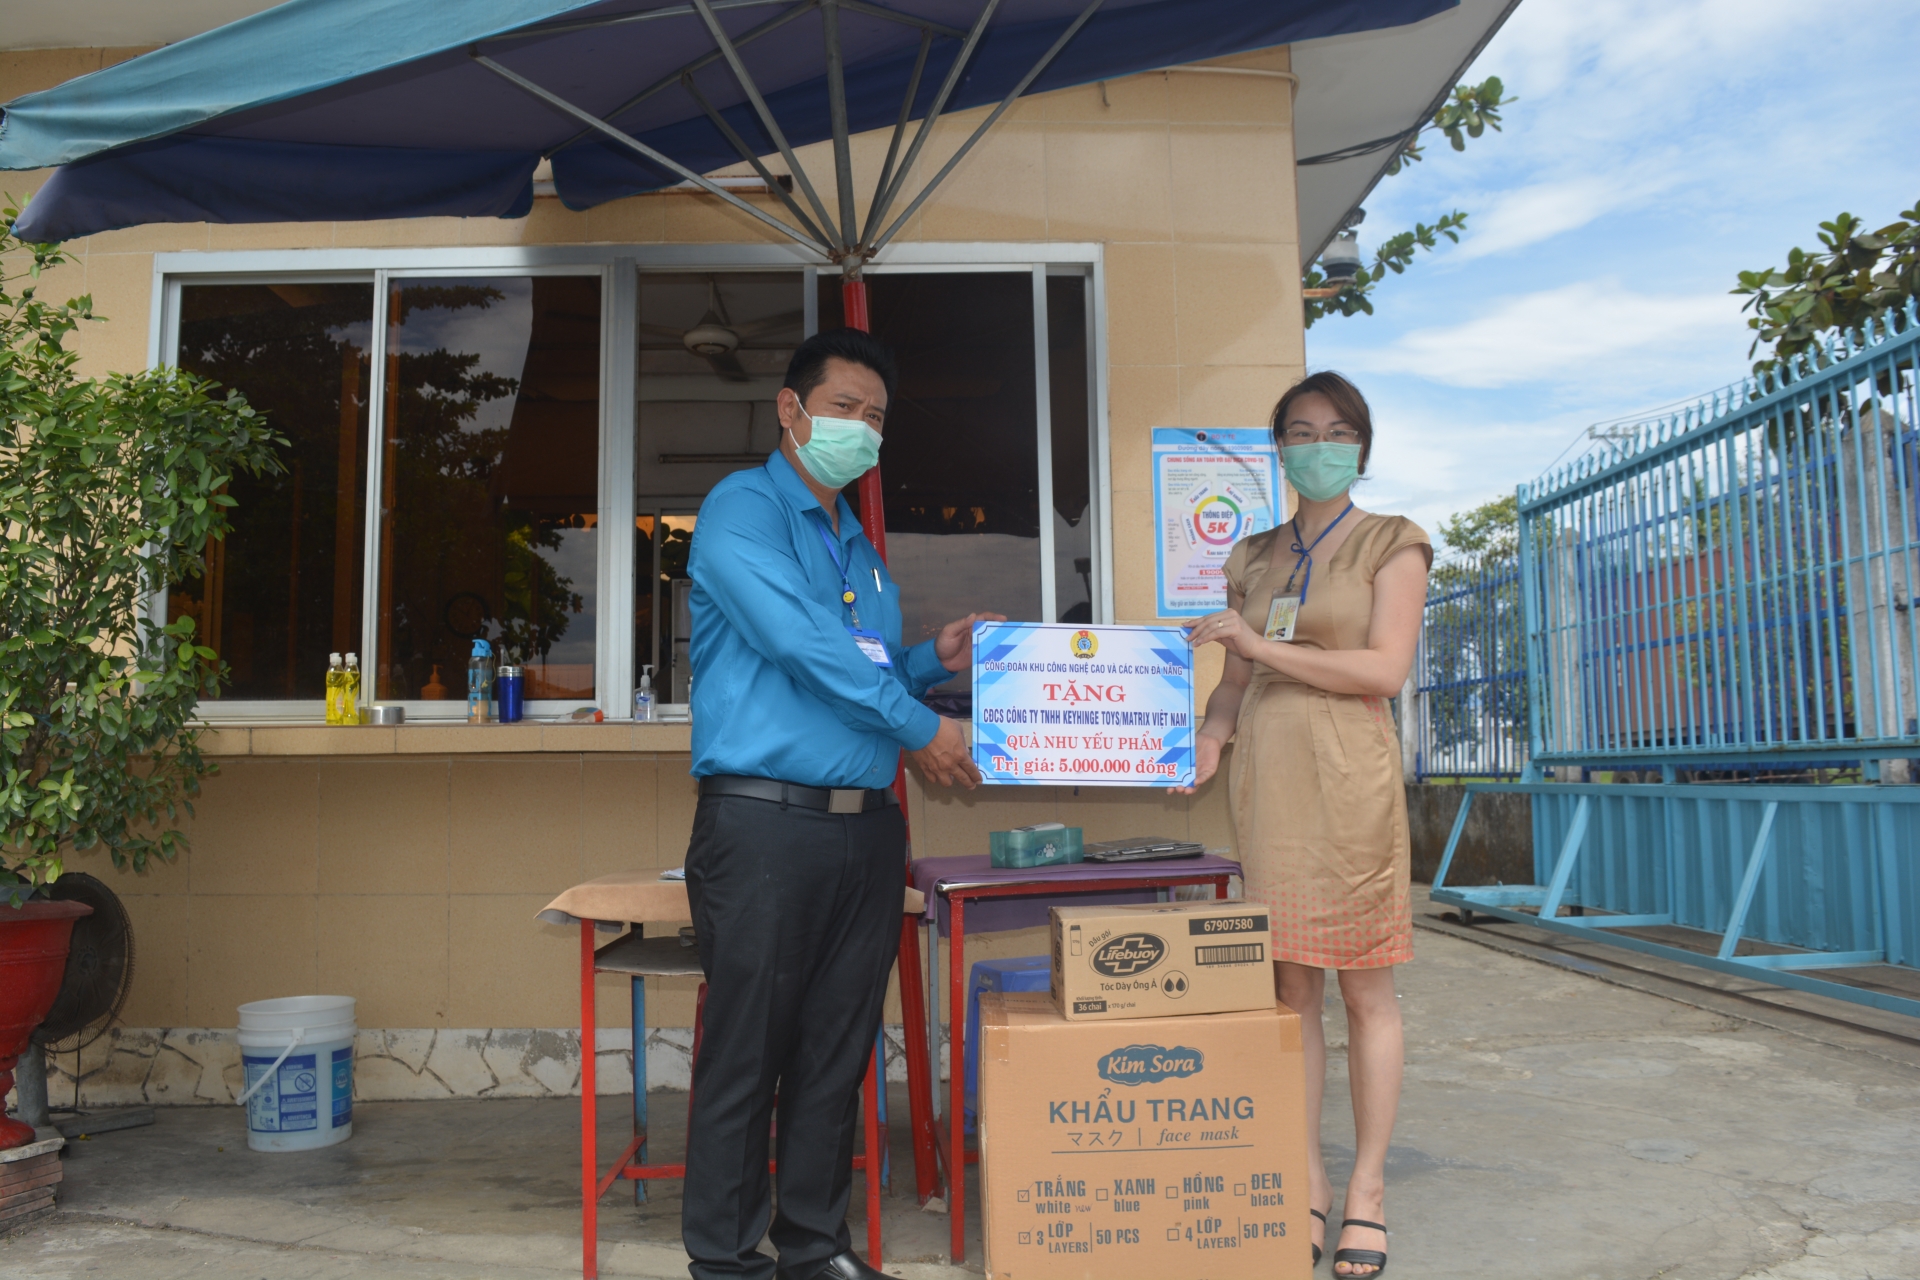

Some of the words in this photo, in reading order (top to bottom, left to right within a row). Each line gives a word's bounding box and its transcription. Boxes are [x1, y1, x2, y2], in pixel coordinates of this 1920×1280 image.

[1202, 510, 1220, 519] THÔNG
[1221, 510, 1234, 520] ĐIỆP
[1207, 521, 1229, 534] 5K
[985, 659, 1005, 671] CÔNG
[1008, 660, 1027, 672] ĐOÀN
[1030, 663, 1044, 672] KHU
[1047, 661, 1066, 672] CÔNG
[1069, 662, 1088, 675] NGHỆ
[1091, 664, 1105, 674] CAO
[1107, 663, 1116, 674] VÀ
[1119, 663, 1132, 674] CÁC
[1135, 665, 1149, 674] KCN
[1151, 663, 1160, 675] ĐÀ
[1163, 662, 1182, 675] NẴNG
[1043, 679, 1126, 706] TẶNG
[984, 708, 1004, 723] CĐCS
[1007, 705, 1027, 723] CÔNG
[1029, 709, 1038, 723] TY
[1040, 709, 1060, 724] TNHH
[1063, 710, 1099, 725] KEYHINGE
[1152, 709, 1168, 729] VIỆT
[1170, 712, 1187, 727] NAM
[1007, 731, 1040, 750] QUÀ
[1044, 735, 1079, 749] NHU
[1082, 731, 1113, 750] YẾU
[1118, 730, 1162, 750] PHẨM
[993, 756, 1018, 776] Trị
[1024, 757, 1054, 775] giá:
[1059, 758, 1130, 773] 5.000.000
[1136, 756, 1176, 777] đồng
[1204, 918, 1254, 931] 67907580
[1088, 936, 1102, 947] Dầu
[1098, 949, 1161, 961] Lifebuoy
[1100, 982, 1114, 991] Tóc
[1116, 981, 1131, 991] Dày
[1133, 979, 1150, 991] Óng
[1078, 1003, 1087, 1011] 36
[1088, 1002, 1102, 1011] chai
[1107, 1056, 1146, 1075] Kim
[1150, 1055, 1195, 1073] Sora
[1049, 1087, 1135, 1124] KHẨU
[1146, 1096, 1254, 1122] TRANG
[1067, 1129, 1123, 1147] マスク
[1156, 1128, 1191, 1146] face
[1200, 1126, 1240, 1142] mask
[1035, 1174, 1086, 1197] TRẮNG
[1114, 1178, 1155, 1196] XANH
[1183, 1171, 1225, 1193] HỒNG
[1250, 1172, 1282, 1190] ĐEN
[1036, 1200, 1071, 1214] white
[1114, 1199, 1140, 1212] blue
[1184, 1196, 1210, 1212] pink
[1251, 1192, 1284, 1207] black
[1048, 1220, 1074, 1238] LỚP
[1197, 1215, 1222, 1234] LỚP
[1243, 1223, 1258, 1239] 50
[1263, 1221, 1286, 1238] PCS
[1037, 1230, 1044, 1246] 3
[1096, 1229, 1111, 1245] 50
[1117, 1228, 1140, 1244] PCS
[1185, 1227, 1193, 1242] 4
[1048, 1241, 1088, 1254] LAYERS
[1197, 1236, 1237, 1250] LAYERS
